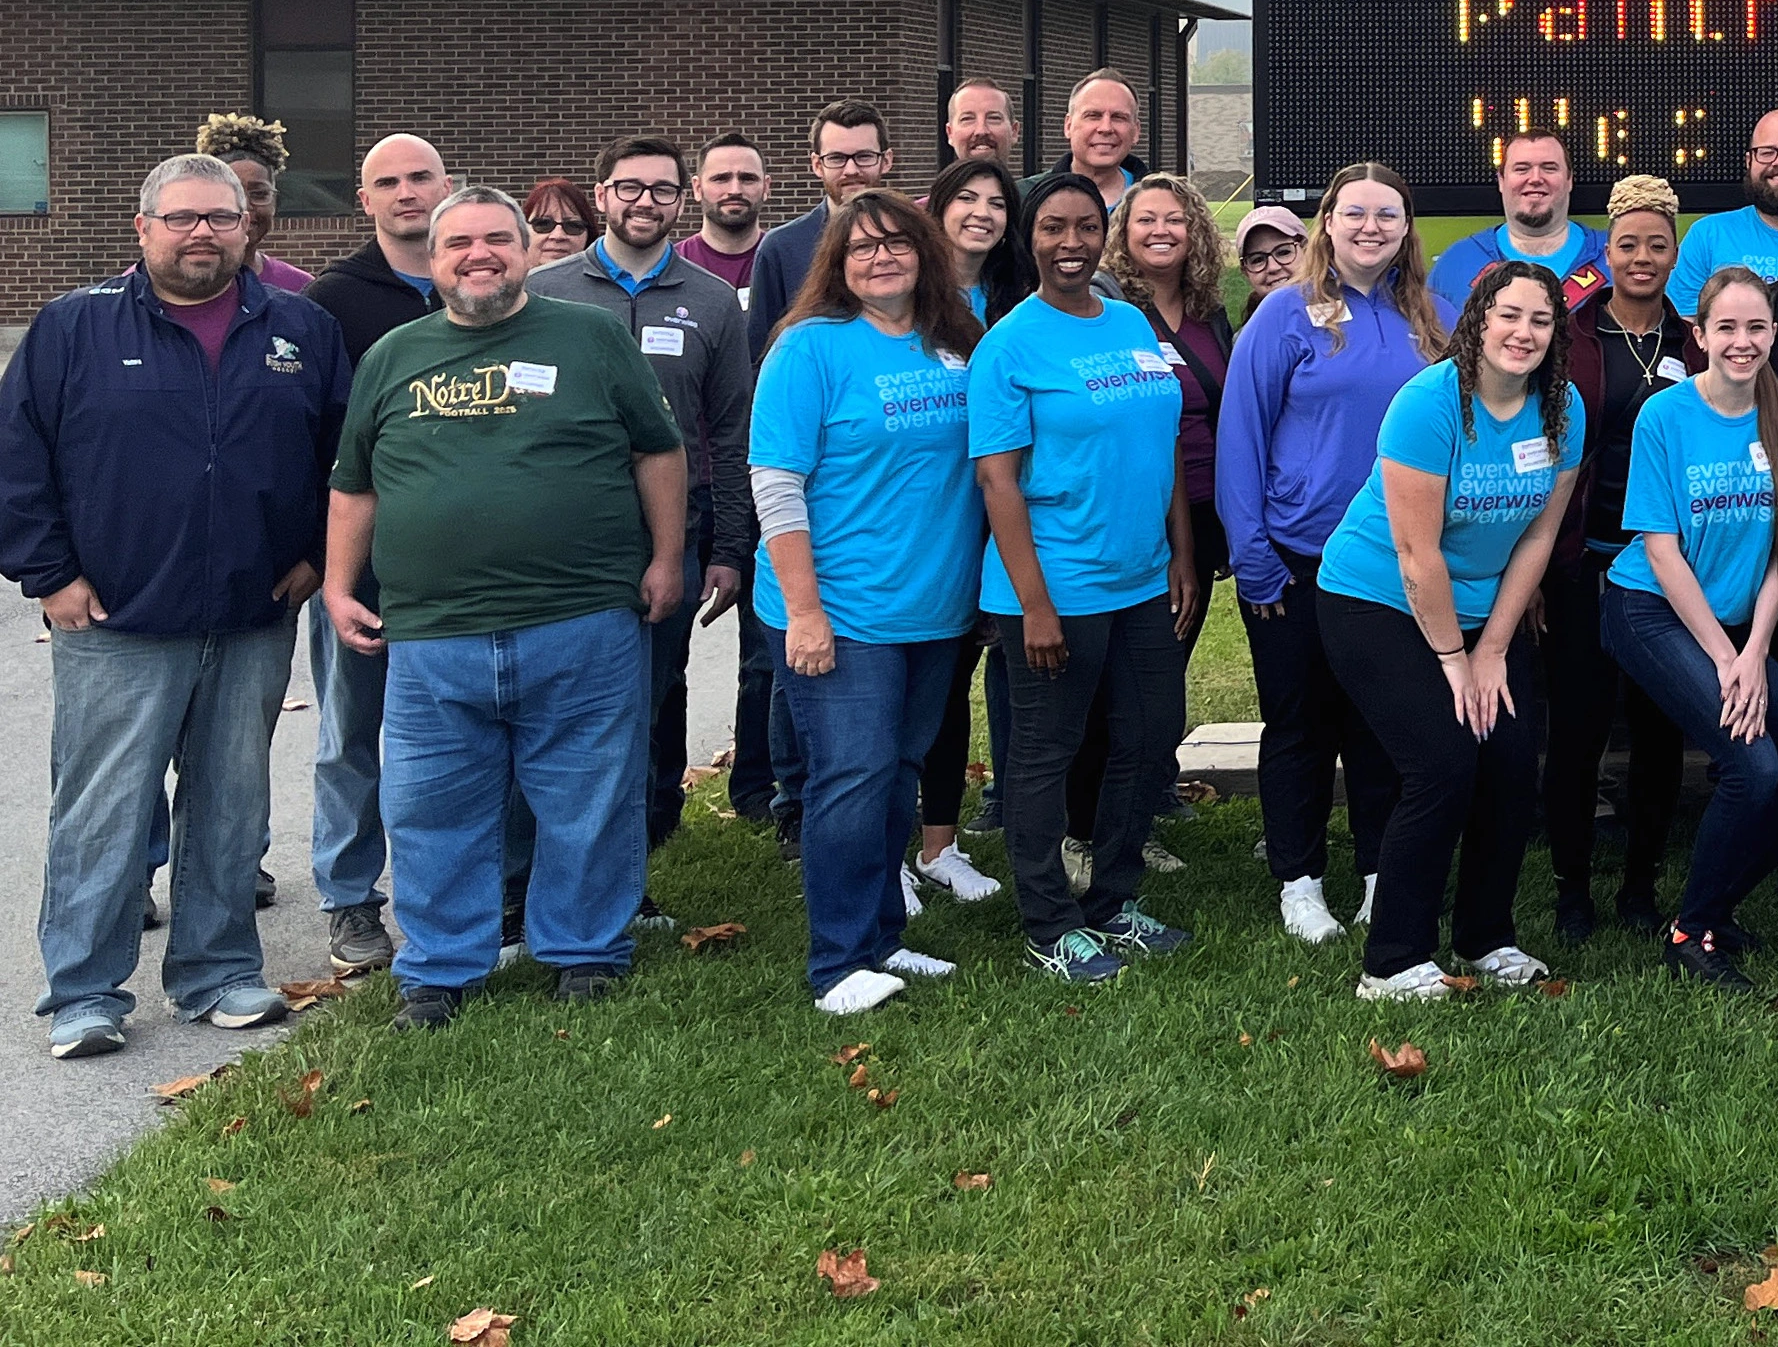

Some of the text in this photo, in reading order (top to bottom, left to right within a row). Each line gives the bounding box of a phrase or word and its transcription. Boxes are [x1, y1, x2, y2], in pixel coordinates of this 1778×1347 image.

[883, 392, 967, 417] everwis
[884, 408, 968, 432] everwis
[1688, 475, 1774, 497] everwis
[1690, 491, 1773, 514] everwis
[1690, 506, 1772, 528] everwis
